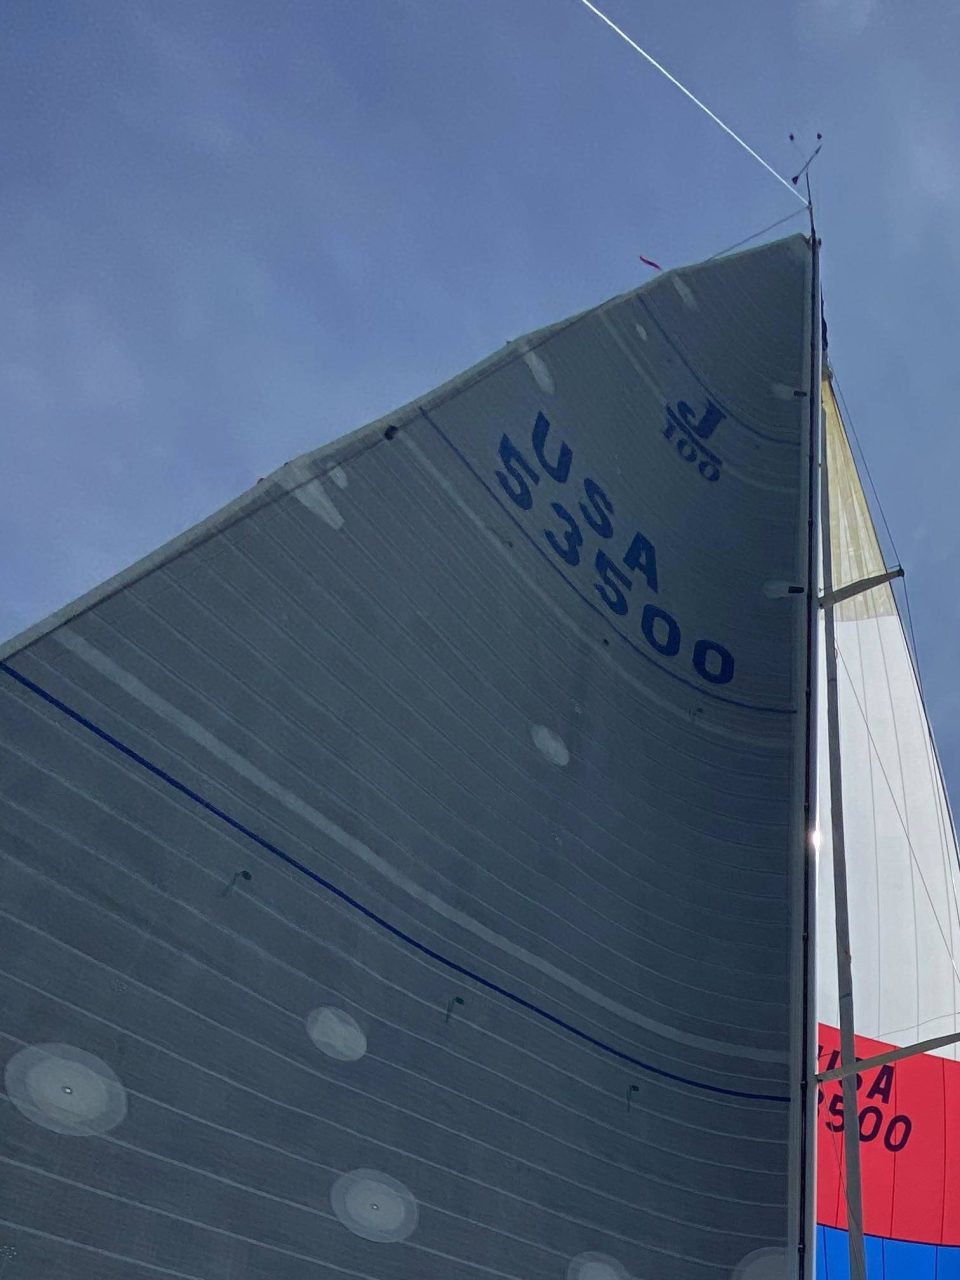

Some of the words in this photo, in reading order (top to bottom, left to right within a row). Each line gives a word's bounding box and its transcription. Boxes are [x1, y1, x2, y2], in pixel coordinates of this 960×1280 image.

[532, 411, 658, 593] USA
[662, 421, 720, 481] 100
[496, 433, 734, 684] 53500
